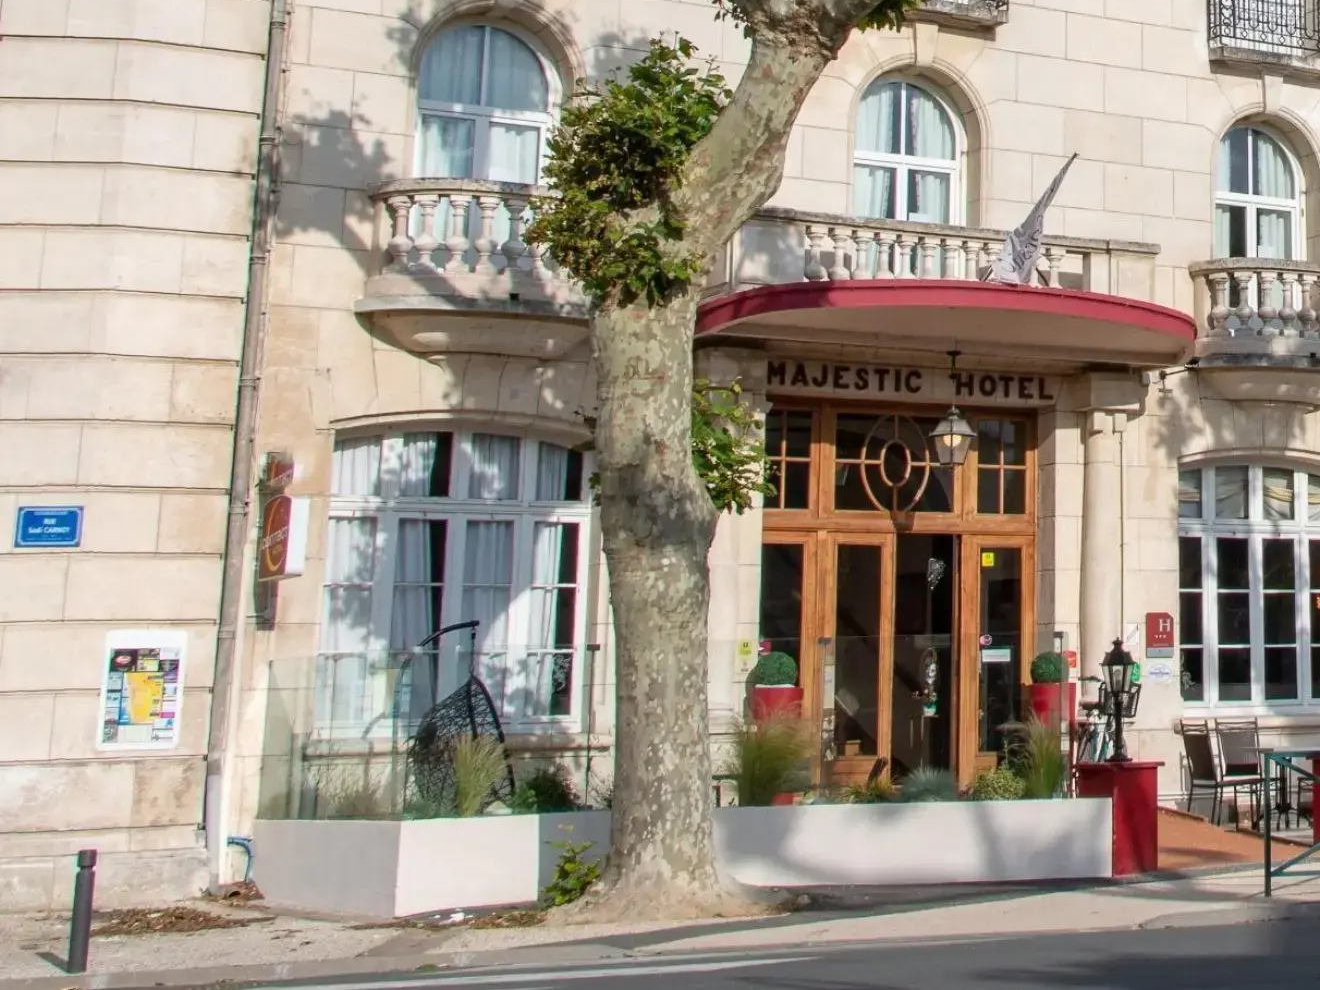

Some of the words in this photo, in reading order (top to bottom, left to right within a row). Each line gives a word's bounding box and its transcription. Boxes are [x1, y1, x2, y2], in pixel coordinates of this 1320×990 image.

[767, 360, 922, 394] MAJESTIC
[955, 372, 1055, 401] HOTEL
[43, 517, 57, 525] RUE
[44, 526, 71, 534] CARNOT
[1158, 618, 1171, 633] H
